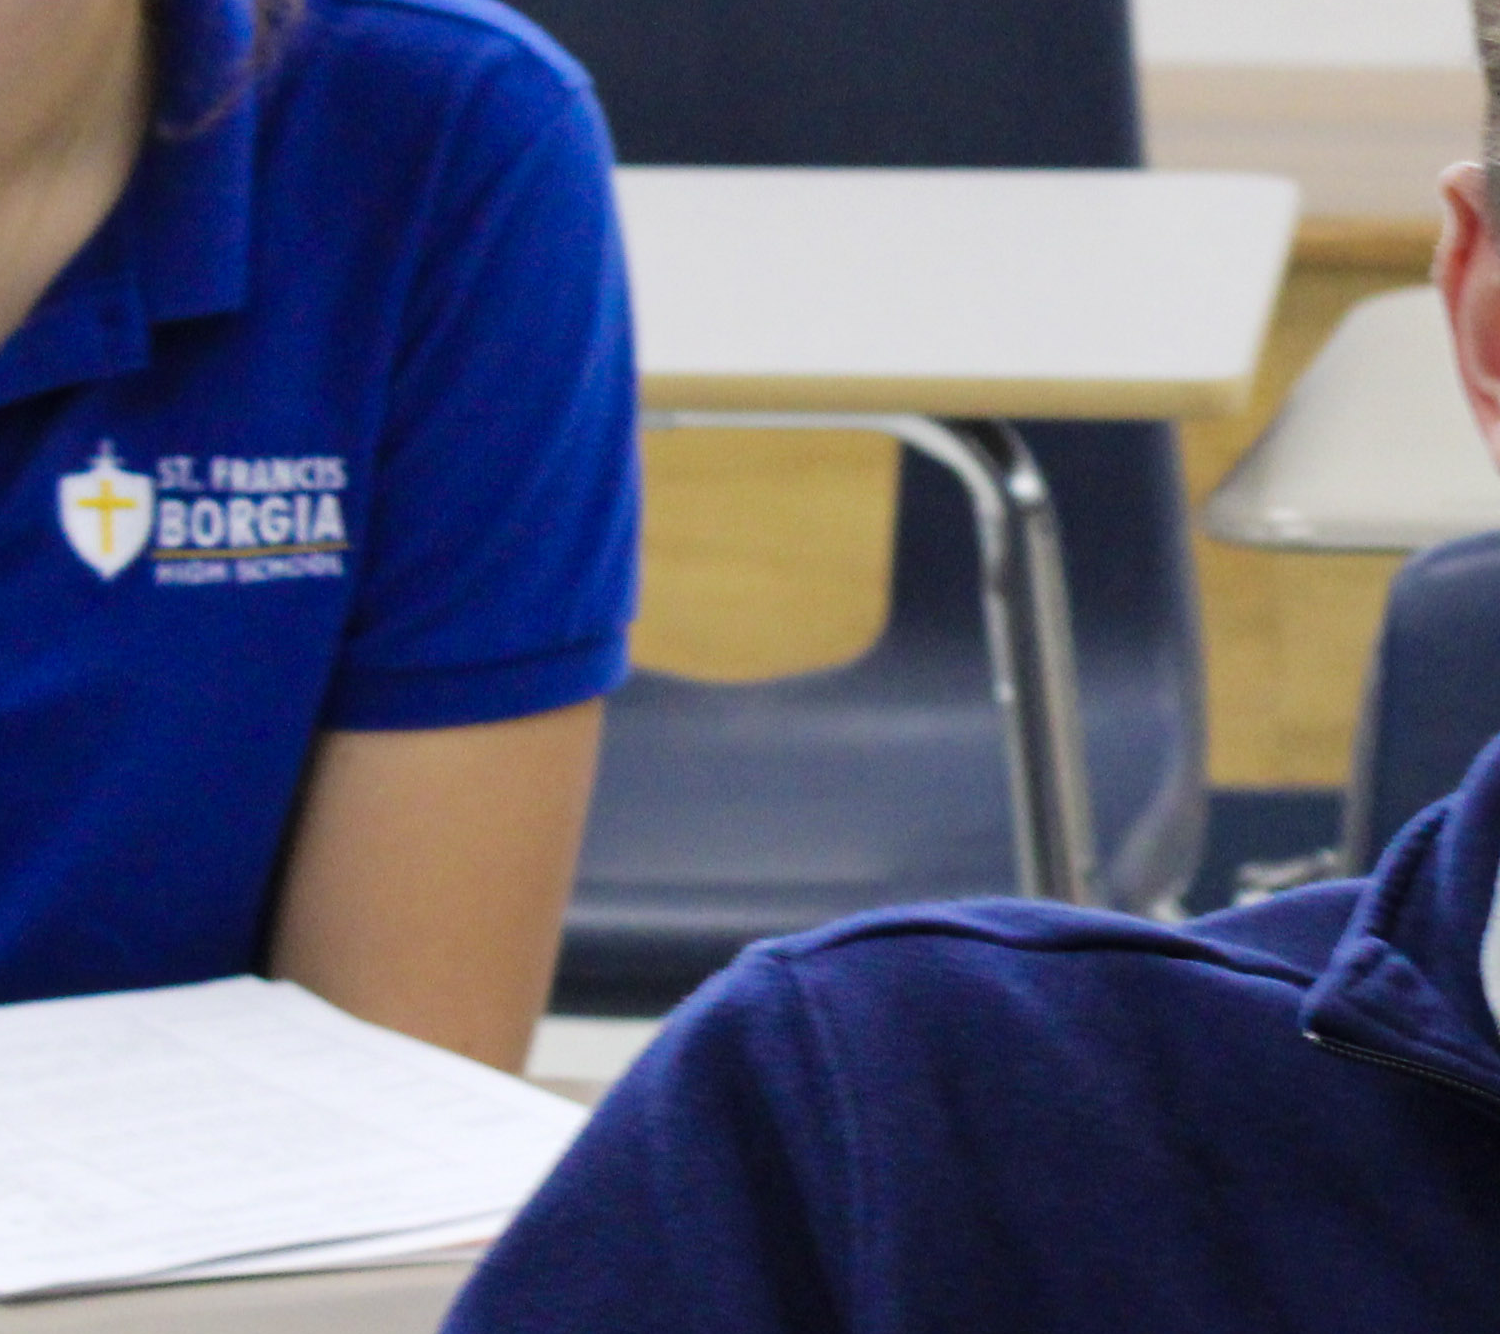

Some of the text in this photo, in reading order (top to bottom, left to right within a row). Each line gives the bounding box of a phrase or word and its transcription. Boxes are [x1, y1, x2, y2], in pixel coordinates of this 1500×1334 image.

[156, 455, 347, 491] ST. FRANCIS
[158, 493, 346, 548] BORGIA
